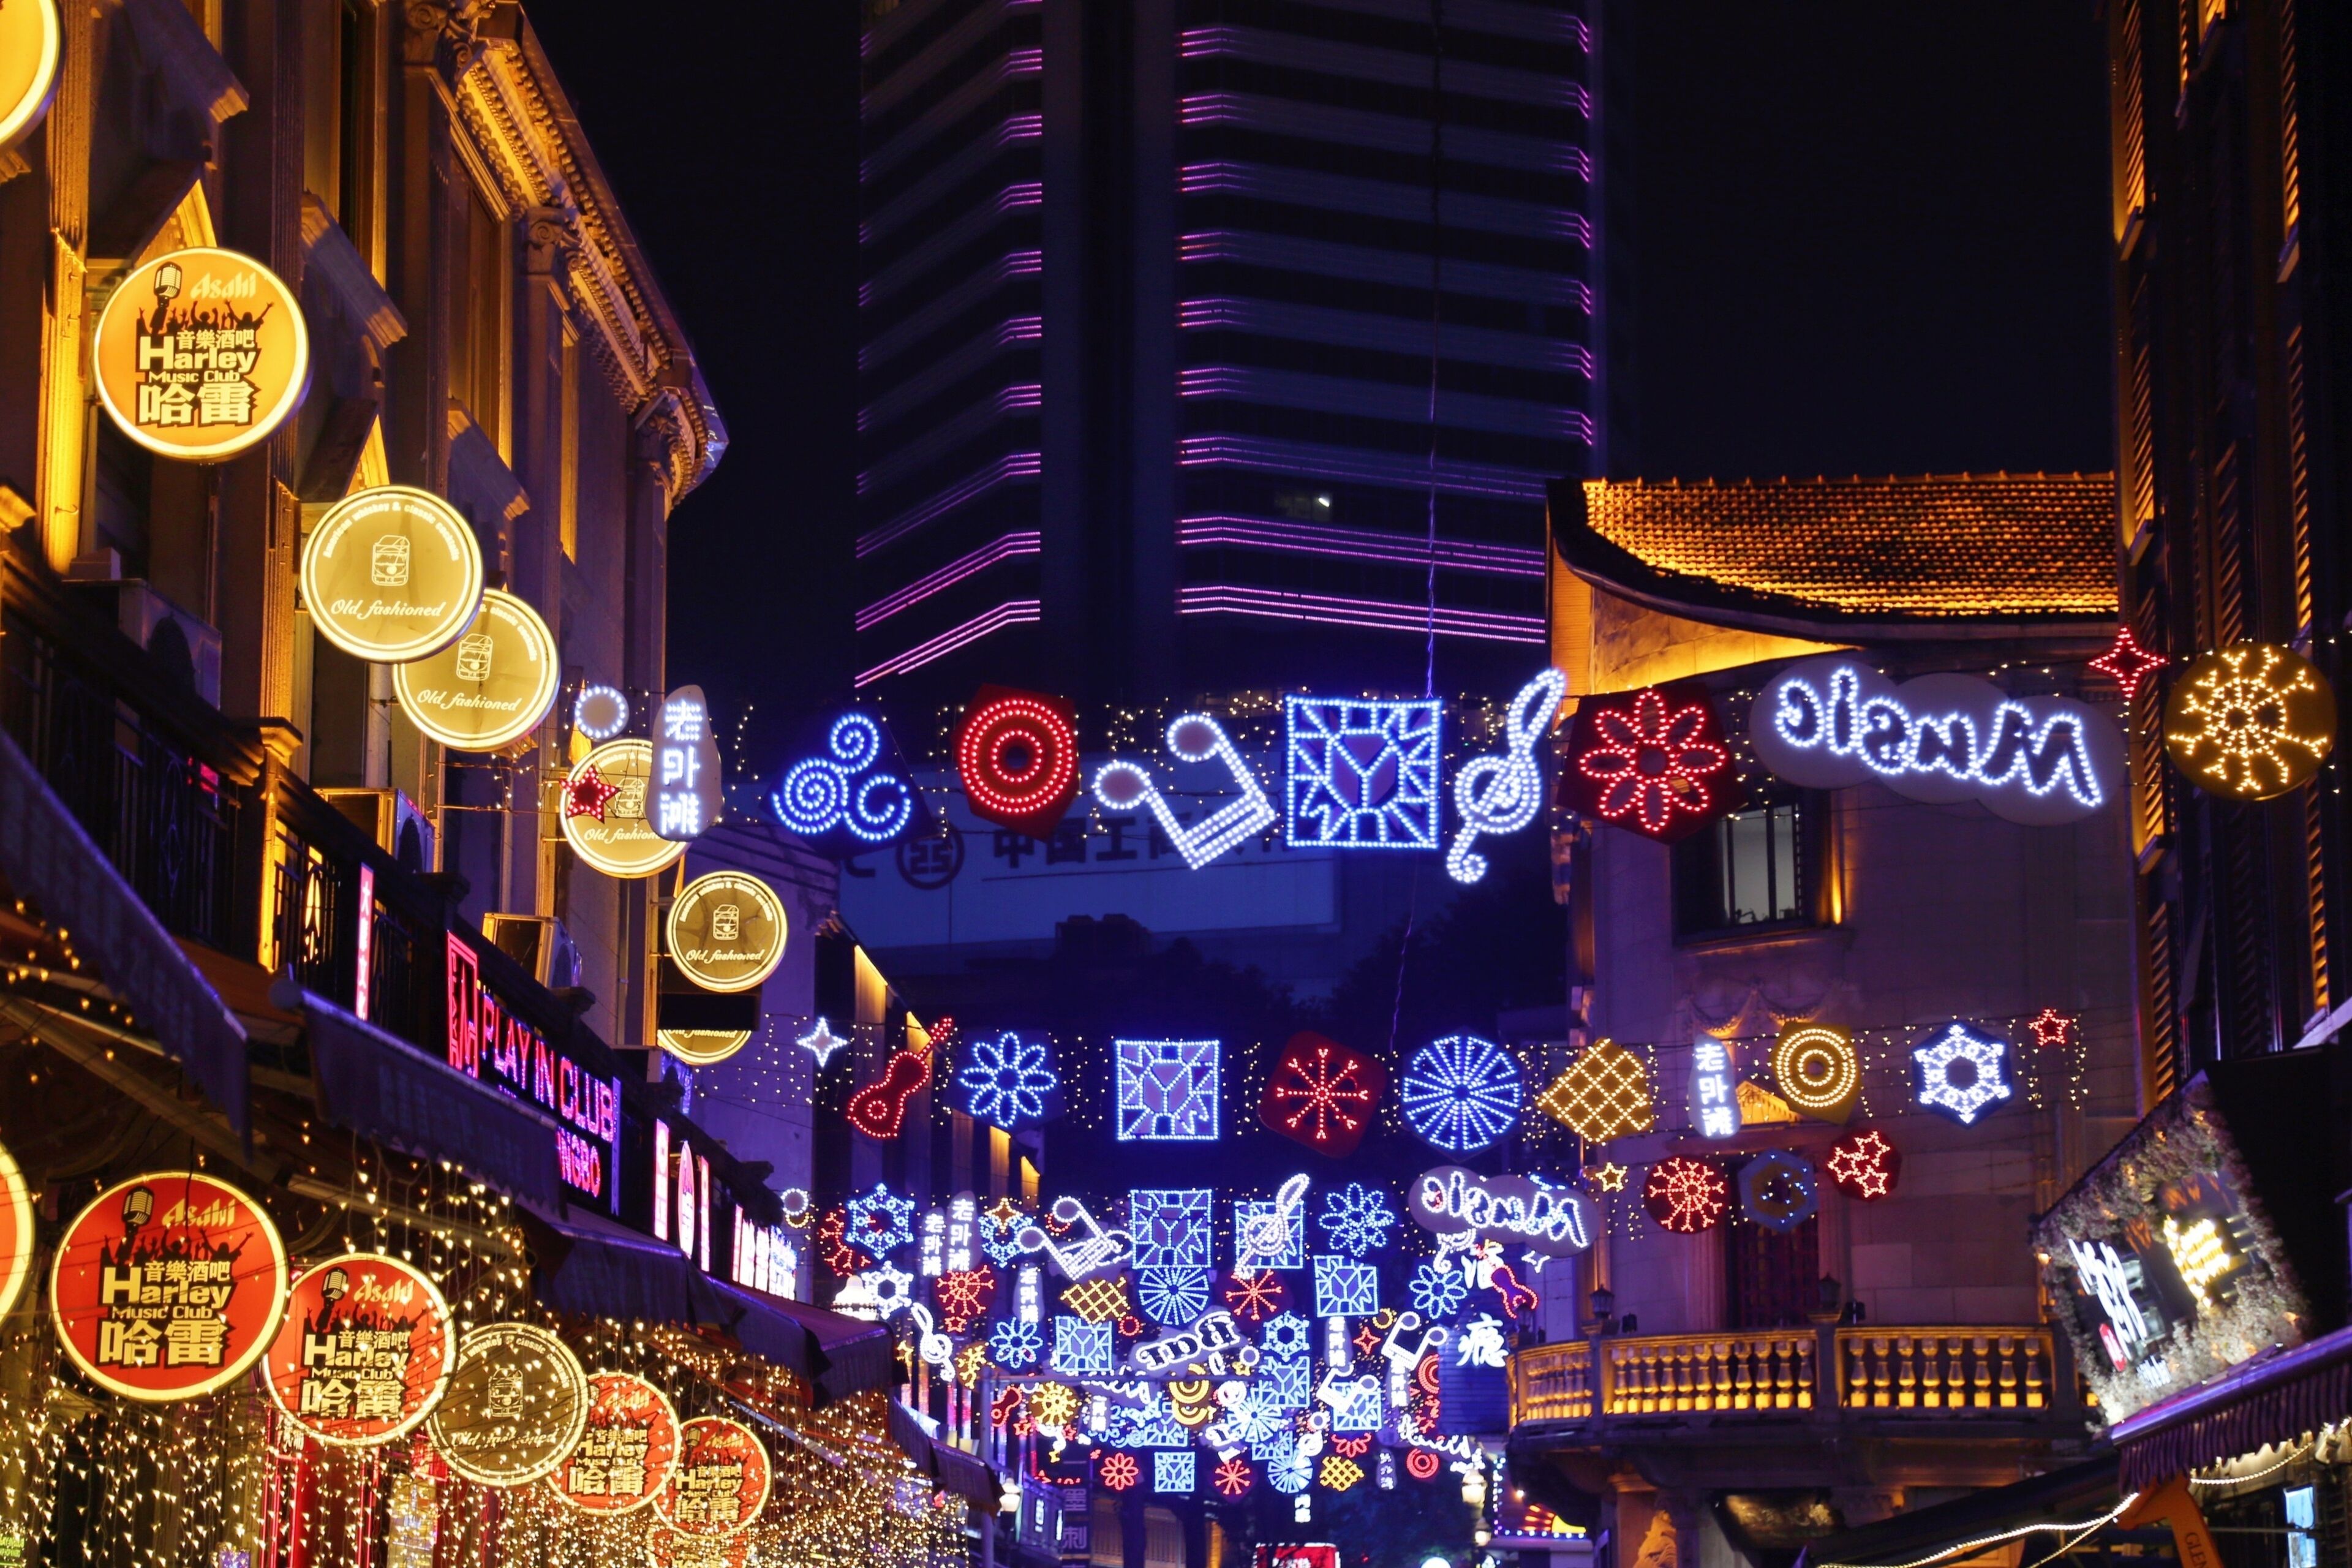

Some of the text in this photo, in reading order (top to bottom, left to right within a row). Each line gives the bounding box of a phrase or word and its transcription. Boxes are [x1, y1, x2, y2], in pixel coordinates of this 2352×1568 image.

[190, 271, 256, 299] Asahi
[176, 329, 255, 350] 音樂酒吧
[140, 336, 256, 372] Harley
[149, 370, 239, 383] Music Club
[139, 382, 254, 424] 哈雷
[331, 599, 447, 619] Old fashioned
[417, 689, 522, 711] Old fashioned
[584, 828, 660, 844] Old fashion
[686, 949, 765, 964] Old fashioned
[482, 993, 532, 1090] PLAY
[560, 1056, 614, 1144] CLUB
[162, 1198, 236, 1227] Asahi
[144, 1260, 231, 1282] 音樂酒吧
[102, 1267, 232, 1308] Harley
[353, 1278, 415, 1303] Asahi
[112, 1306, 213, 1319] Music Club
[99, 1319, 227, 1365] 哈雷
[339, 1330, 411, 1350] 音樂酒吧
[304, 1334, 409, 1373] Harley
[361, 1368, 394, 1380] Club
[301, 1379, 406, 1419] 哈雷
